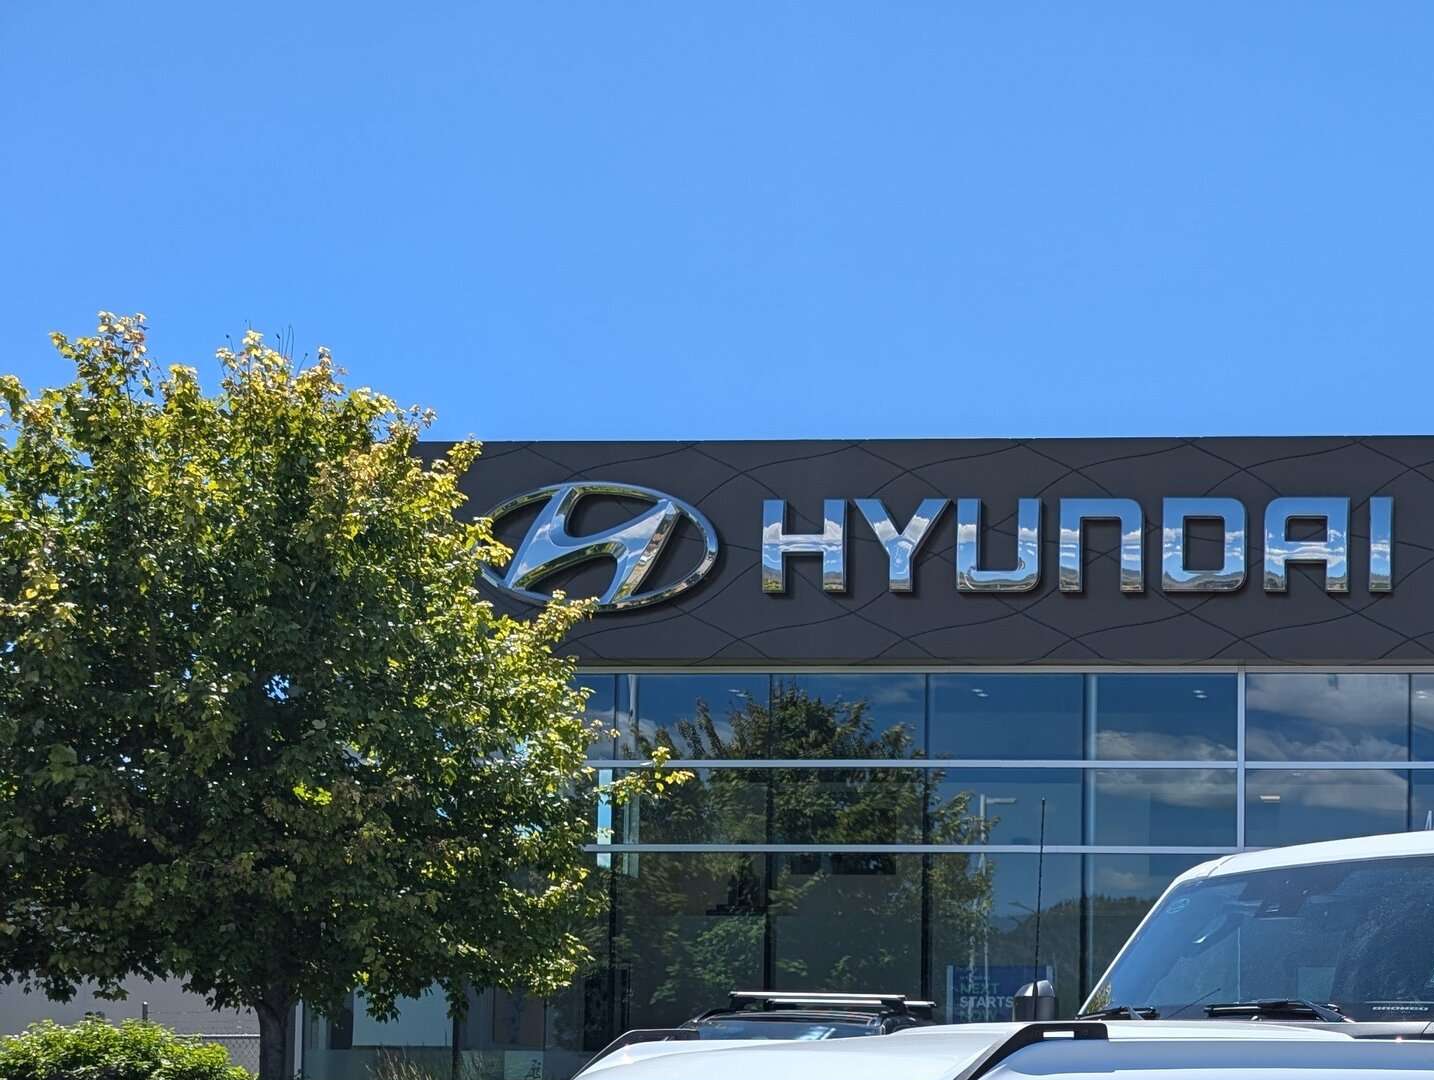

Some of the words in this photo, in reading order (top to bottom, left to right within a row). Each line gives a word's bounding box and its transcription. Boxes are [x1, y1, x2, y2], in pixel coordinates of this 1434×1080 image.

[762, 495, 1394, 594] HYUNDAI
[960, 983, 1000, 994] NEXT
[960, 996, 1014, 1009] STARTS
